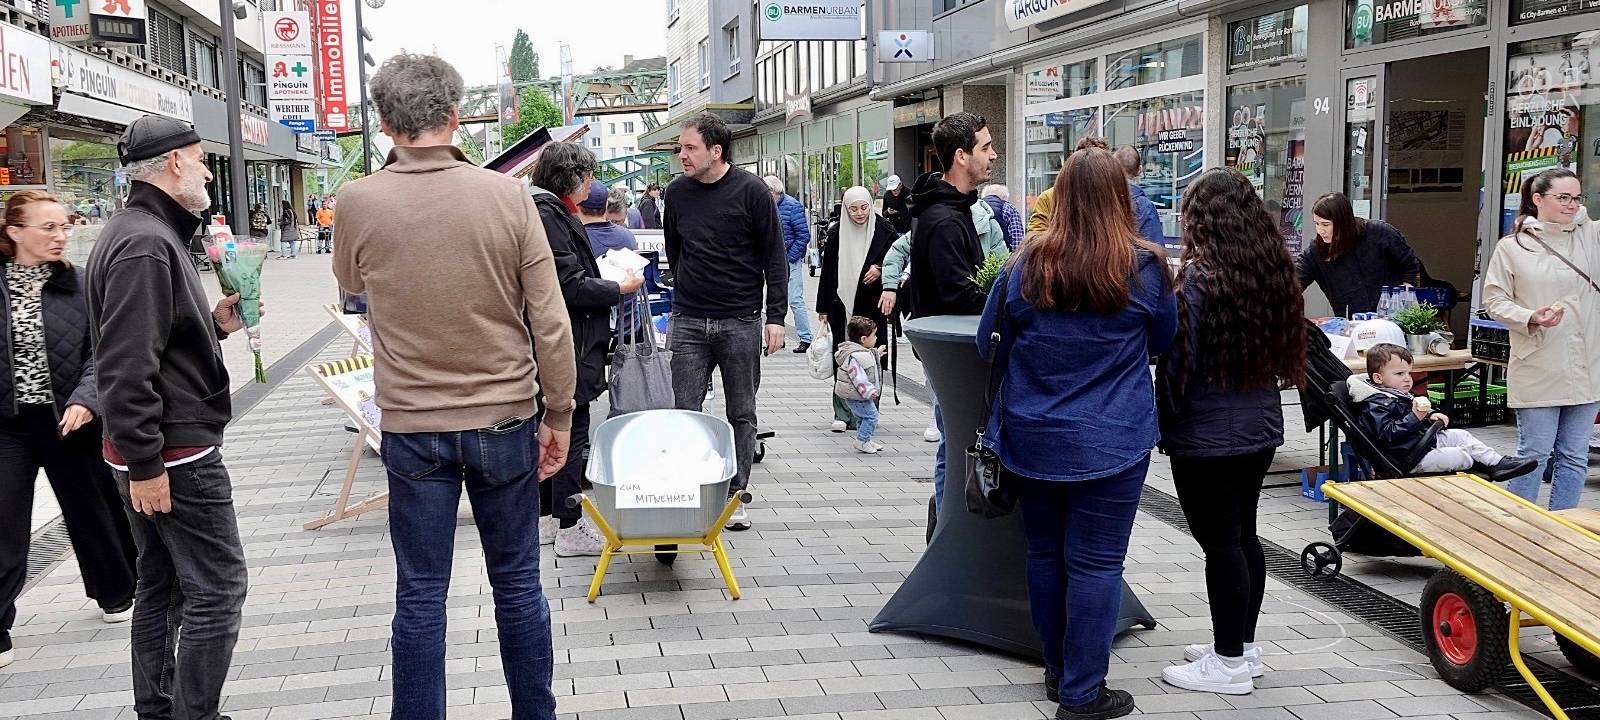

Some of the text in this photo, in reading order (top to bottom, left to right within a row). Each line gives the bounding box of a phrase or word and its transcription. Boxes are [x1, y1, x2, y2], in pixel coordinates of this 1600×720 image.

[783, 6, 858, 15] BARMENURBAN
[1357, 15, 1370, 29] BU
[52, 24, 89, 38] APOTHEKE
[321, 0, 344, 102] Immobilie
[274, 105, 310, 113] WERTHER
[1313, 97, 1330, 115] 94
[1511, 99, 1566, 114] HERZLICHE
[1510, 114, 1569, 129] EINLADUNG
[1158, 130, 1186, 140] WIR GEBEN
[1158, 141, 1193, 152] RÜCKENWIND
[619, 483, 641, 491] ZUM
[635, 494, 695, 504] MITNEHMEN
